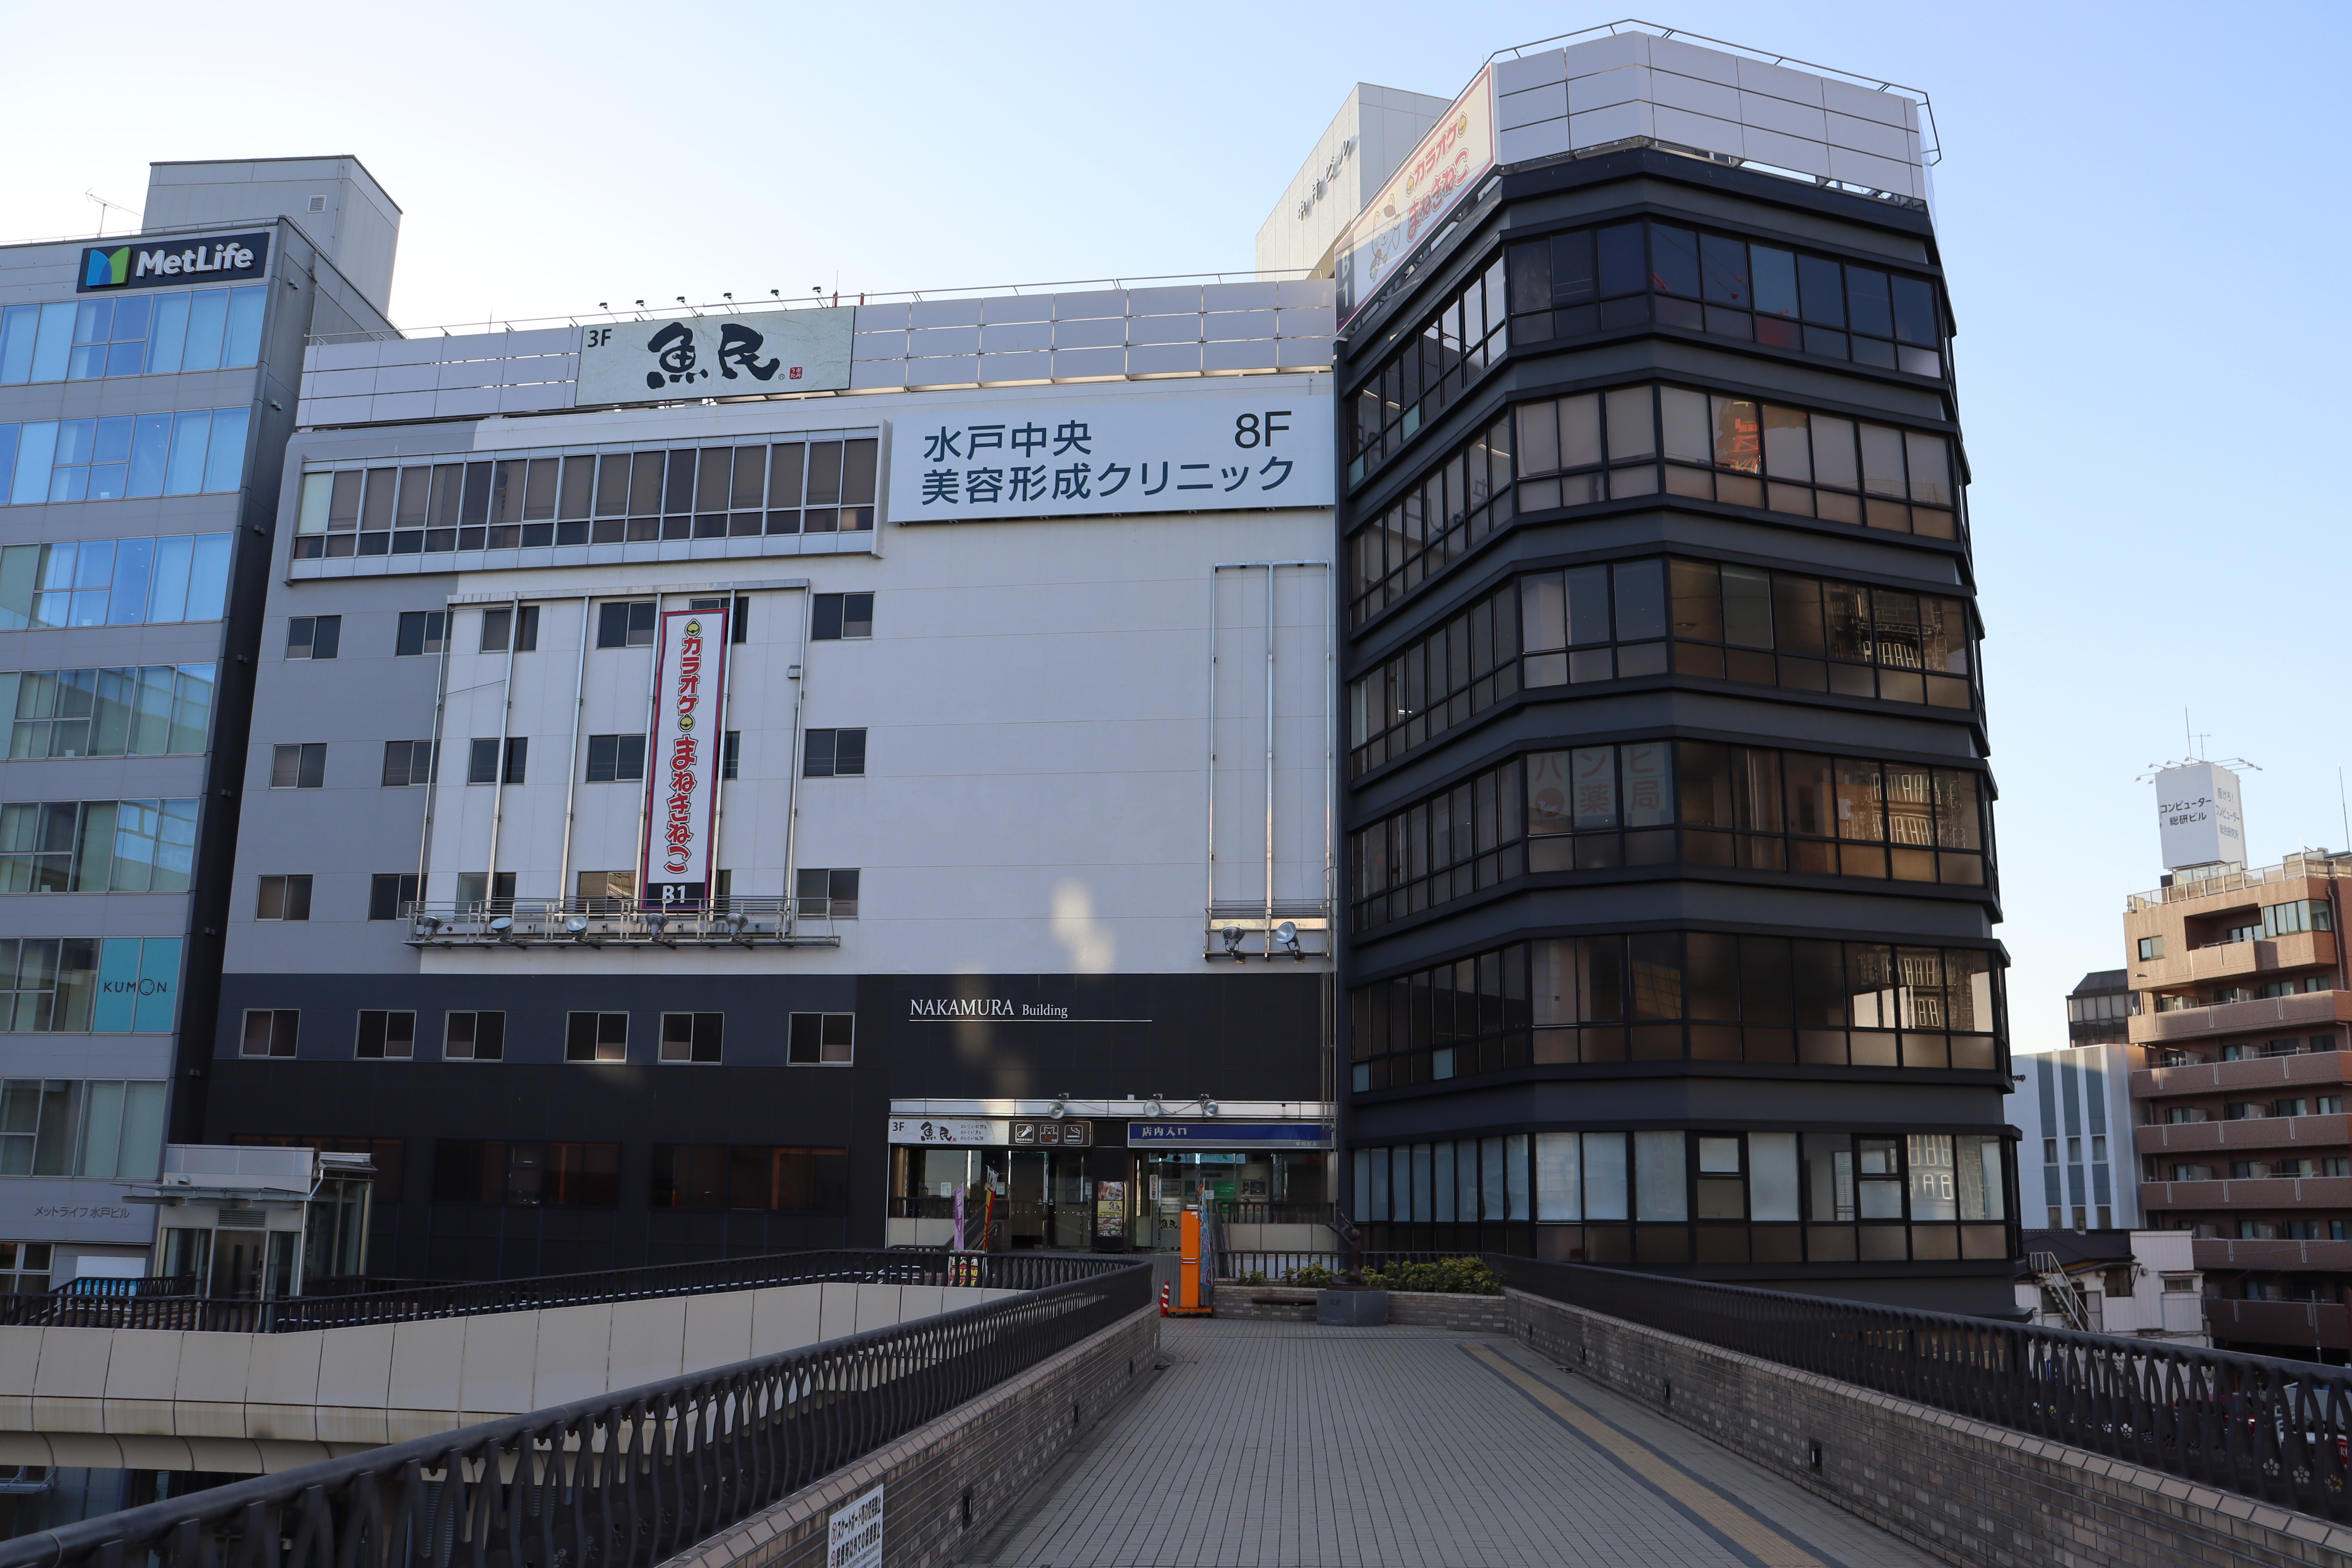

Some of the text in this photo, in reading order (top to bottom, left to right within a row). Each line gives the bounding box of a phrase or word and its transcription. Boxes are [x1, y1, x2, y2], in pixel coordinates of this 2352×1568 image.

[1414, 120, 1459, 193] カラオケ
[1297, 140, 1350, 221] 中村ビル
[1407, 149, 1469, 242] まねきねこ
[136, 242, 254, 279] MetLife
[587, 328, 612, 348] 3F
[647, 321, 780, 390] 魚民
[923, 419, 1092, 463] 水戸中央
[1234, 410, 1292, 449] 8F
[921, 456, 1294, 506] 美容形成クリニック
[678, 638, 702, 715] カラオケ
[1534, 743, 1656, 783] バンビ
[664, 735, 698, 875] まねきねこ
[1579, 779, 1660, 815] 薬局
[2160, 797, 2212, 813] コンピューター
[2215, 804, 2240, 823] コンピューター
[2169, 812, 2207, 826] 総研ビル
[662, 885, 686, 904] B1
[103, 978, 167, 996] KUMON
[910, 999, 1068, 1019] NAKAMURA Building
[893, 1122, 905, 1131] 3F
[920, 1121, 952, 1141] 魚民
[1142, 1126, 1187, 1137] 店内入口
